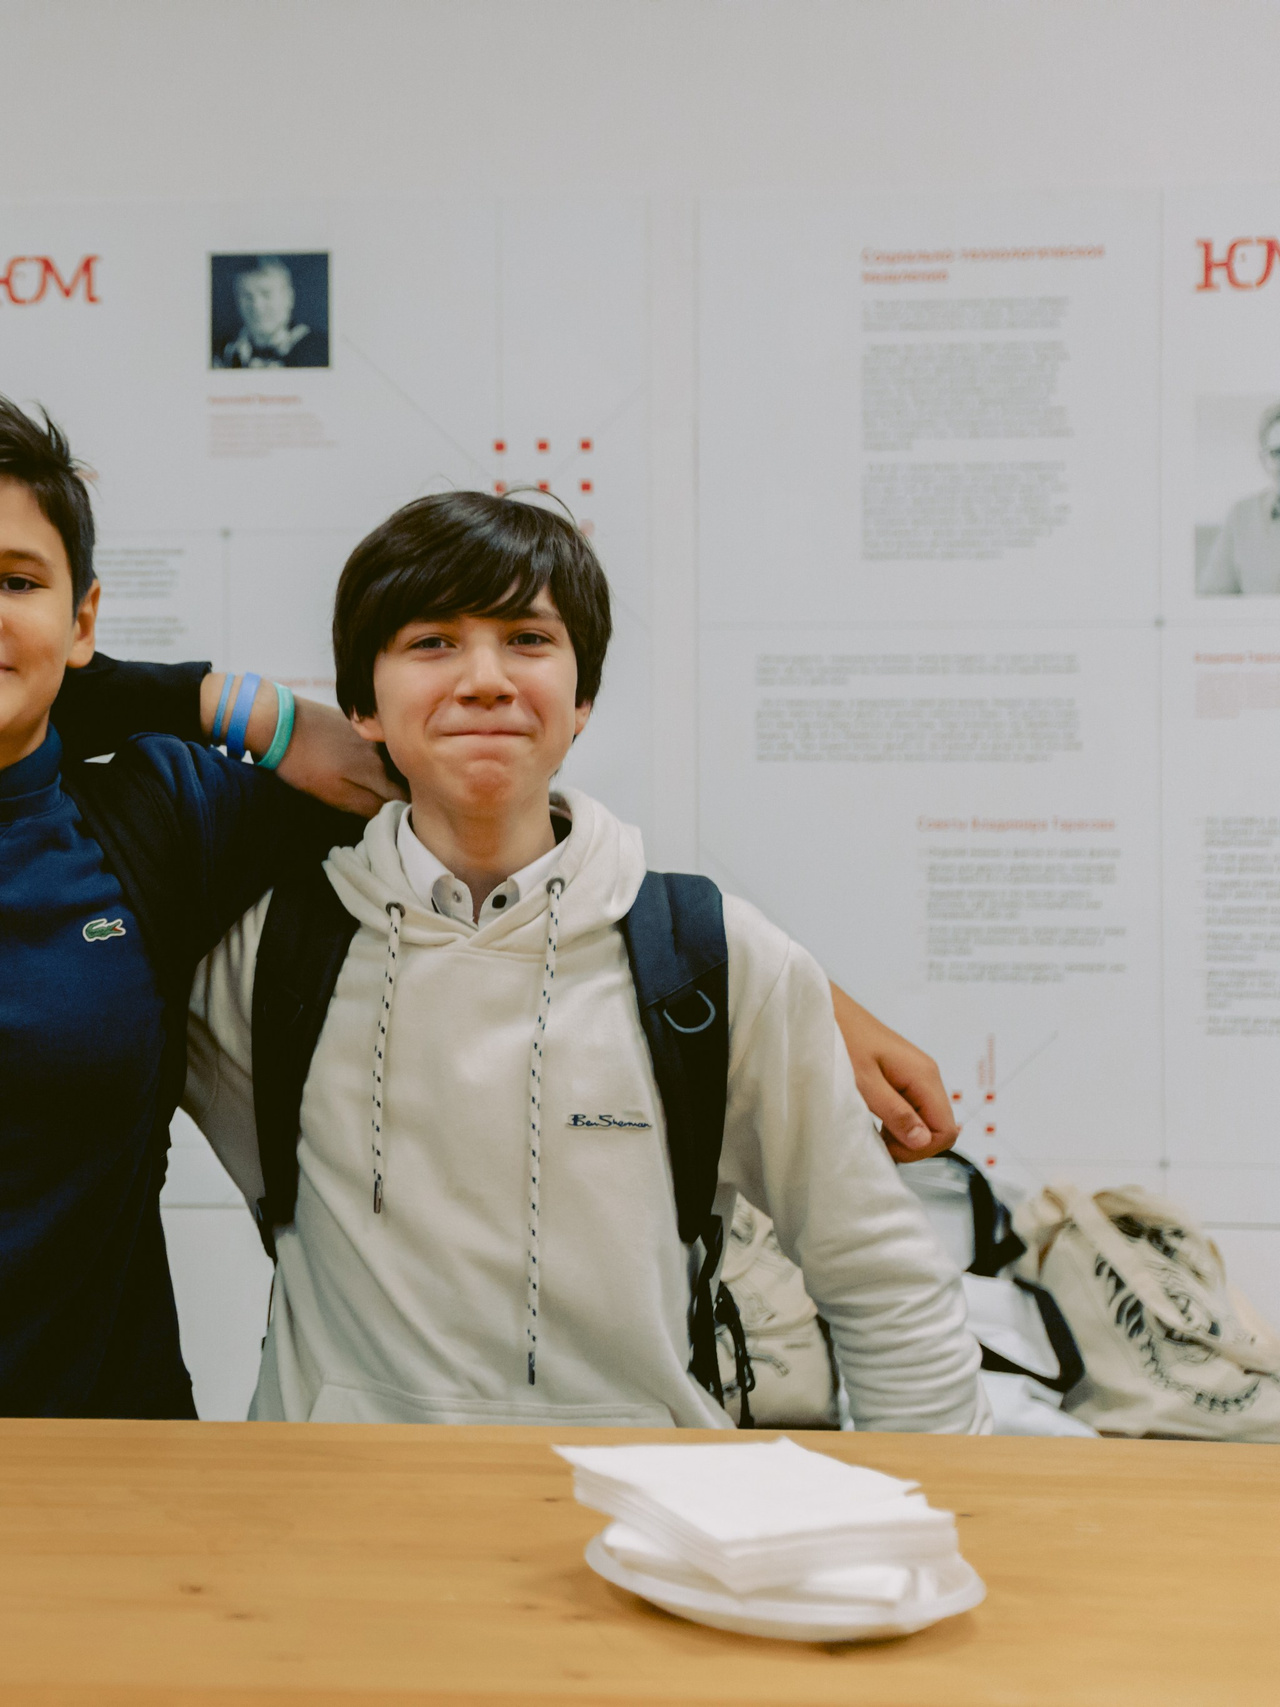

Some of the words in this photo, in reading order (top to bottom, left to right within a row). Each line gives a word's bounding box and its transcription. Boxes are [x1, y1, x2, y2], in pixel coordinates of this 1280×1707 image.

[1195, 236, 1280, 292] Ю
[568, 1113, 599, 1127] Ben
[599, 1114, 652, 1128] Sherman
